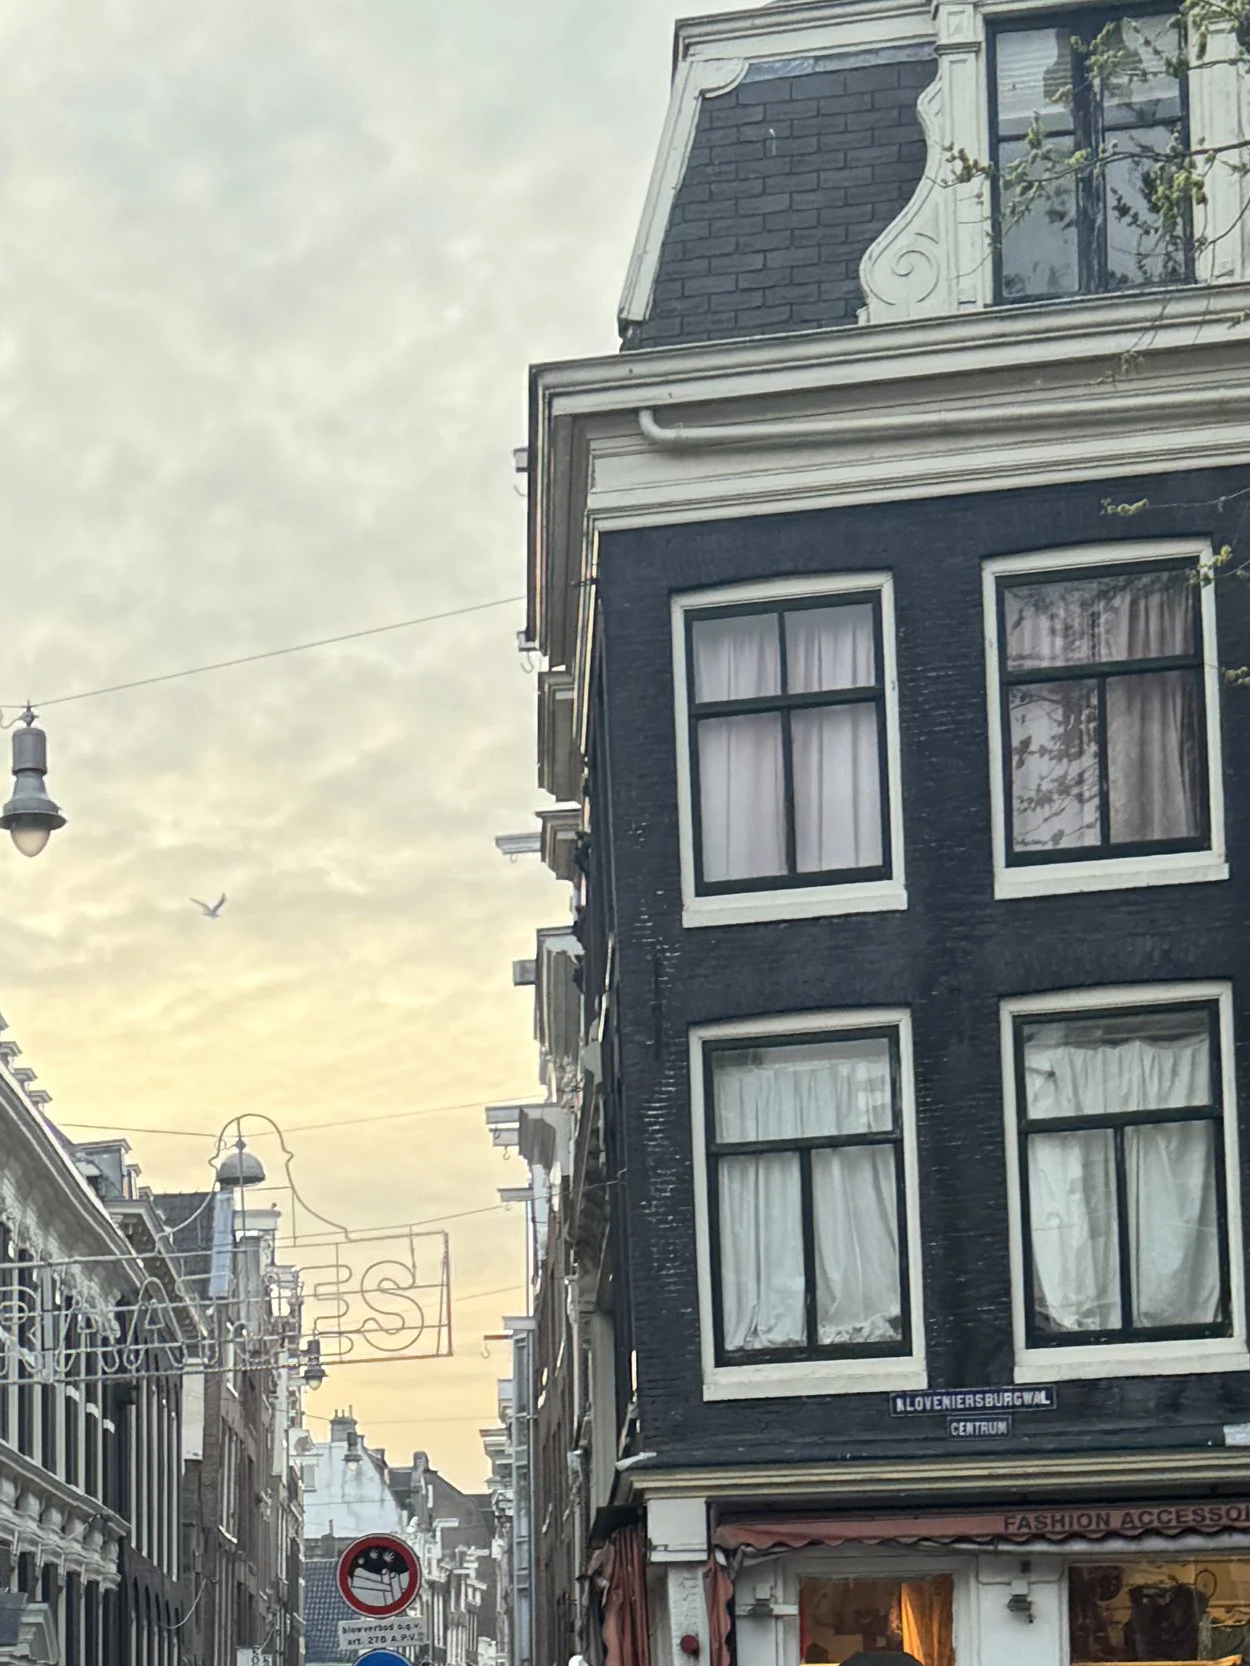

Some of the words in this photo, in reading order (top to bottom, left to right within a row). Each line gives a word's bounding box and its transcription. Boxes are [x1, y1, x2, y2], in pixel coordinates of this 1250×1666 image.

[896, 1390, 1051, 1412] KLOVENIERSBURGWAL
[950, 1421, 1008, 1436] CENTRUM
[1003, 1511, 1111, 1532] FASHION
